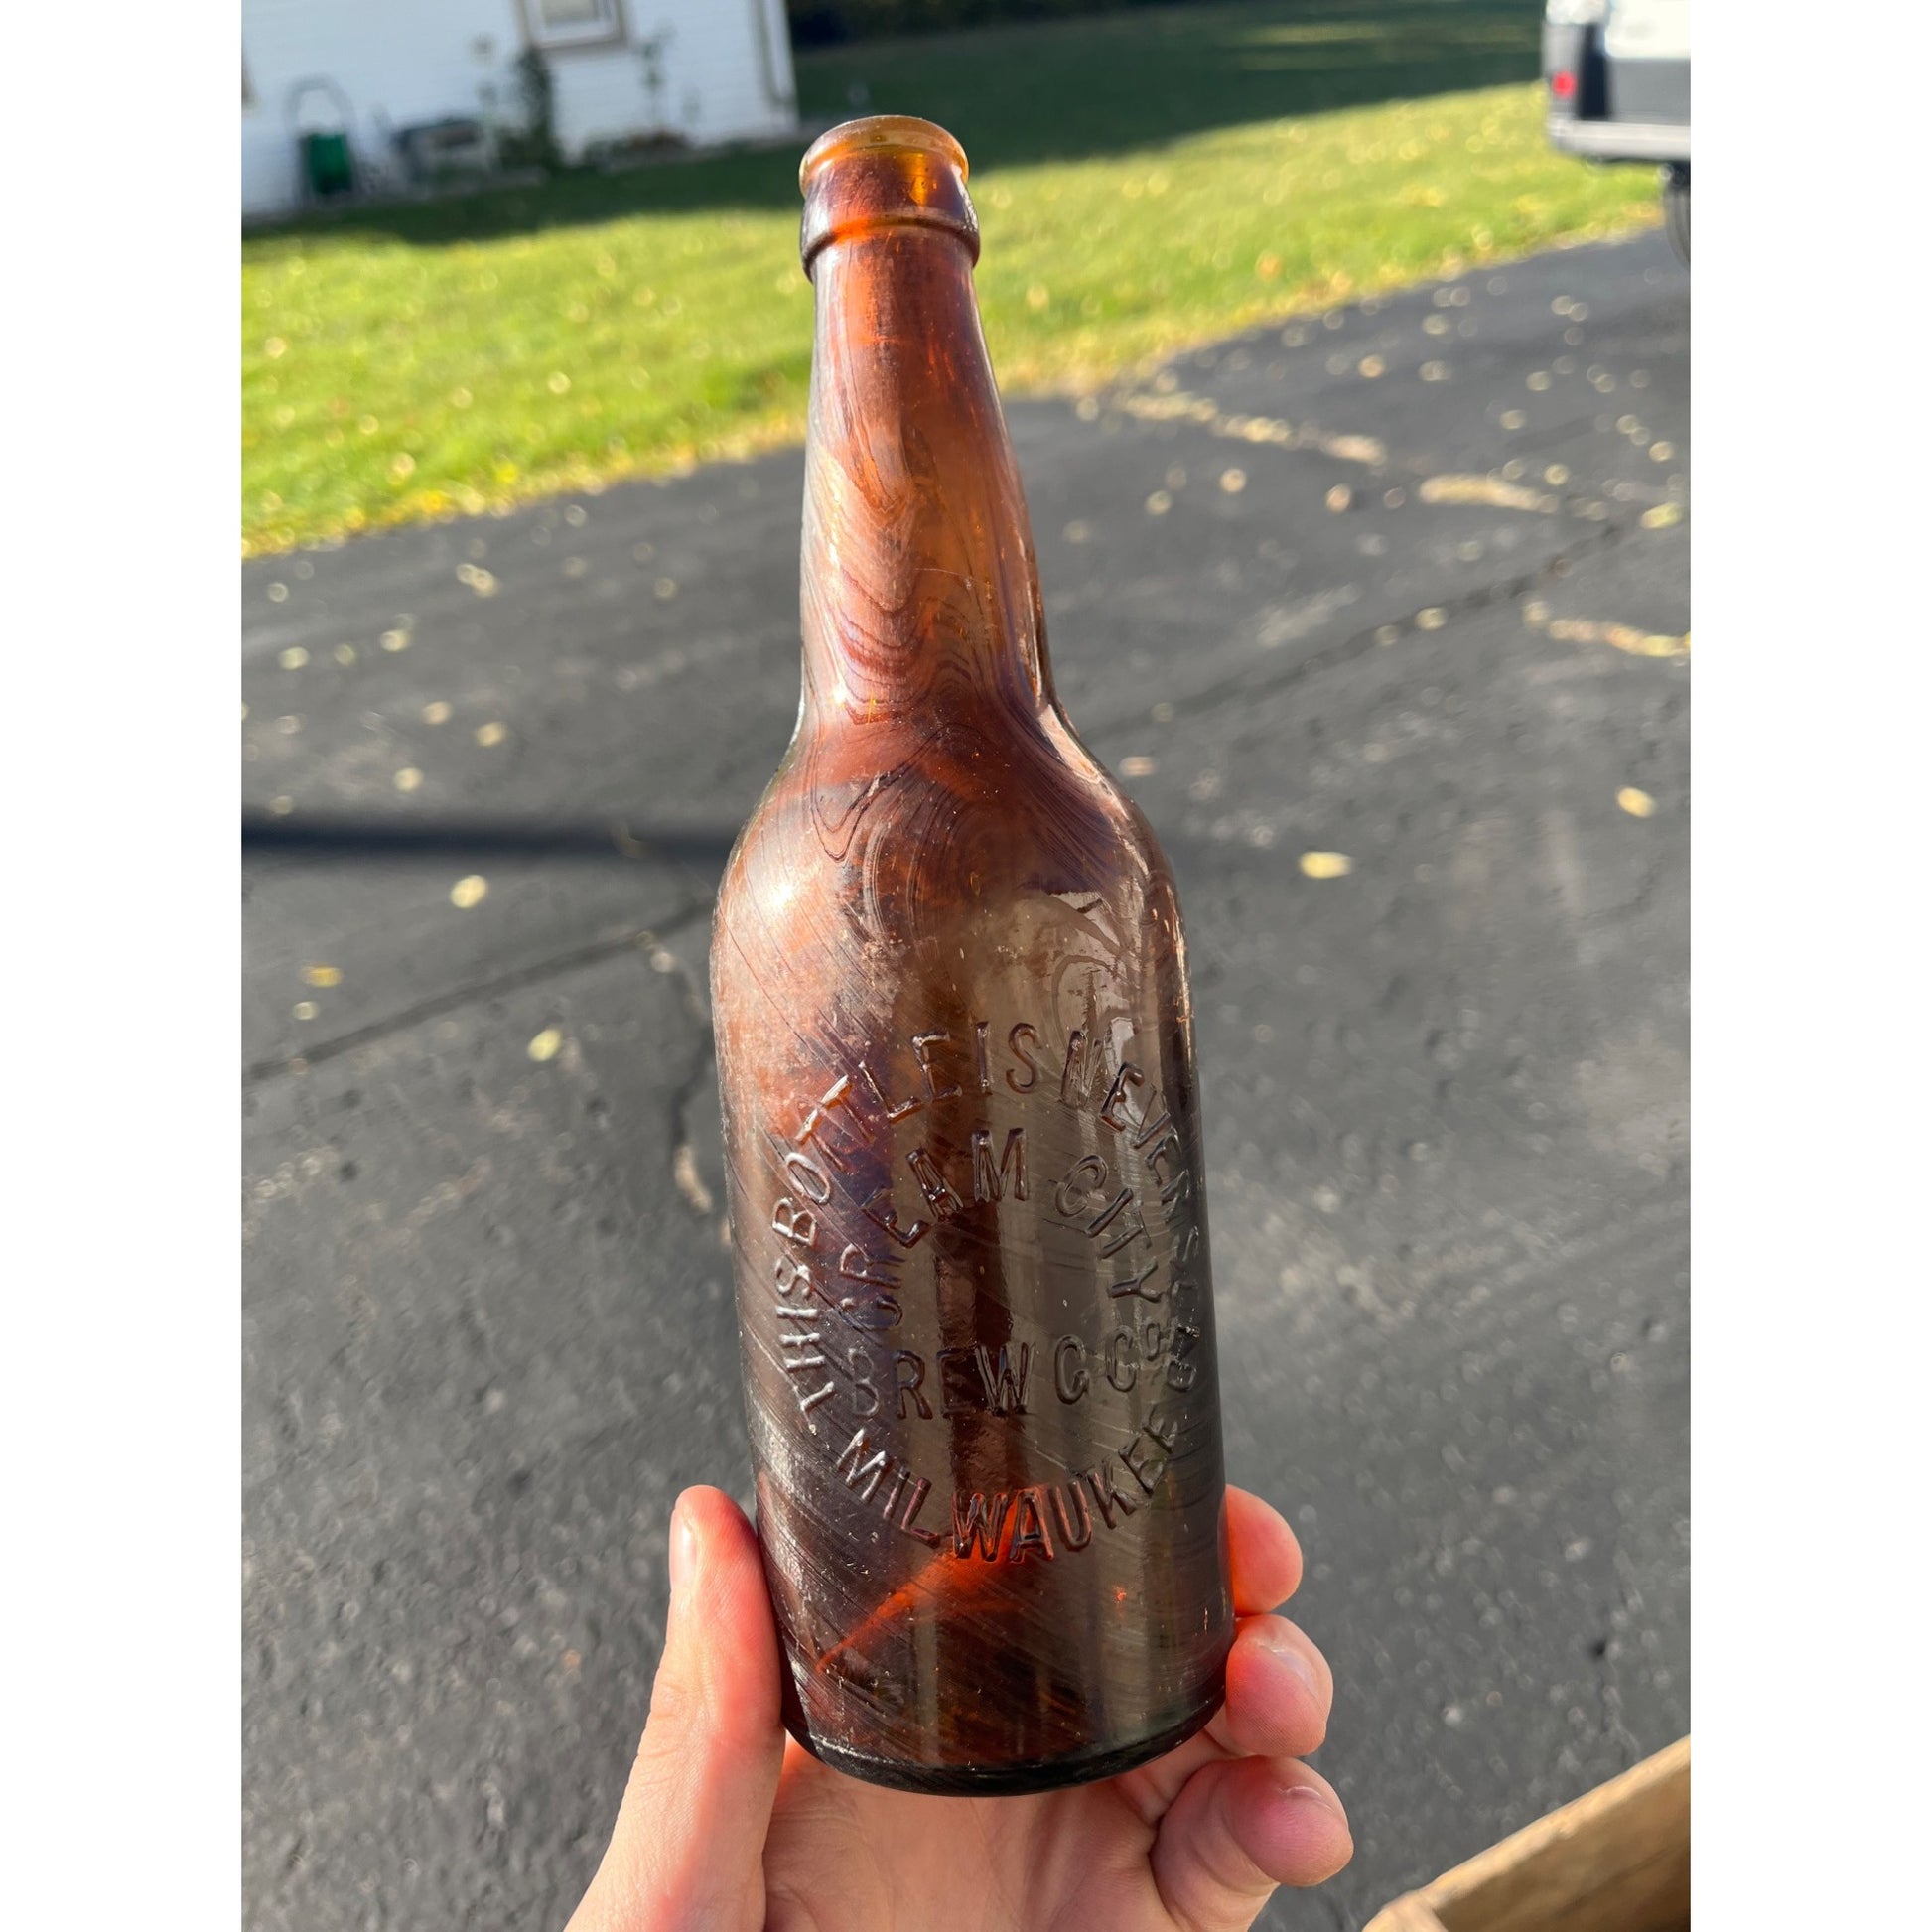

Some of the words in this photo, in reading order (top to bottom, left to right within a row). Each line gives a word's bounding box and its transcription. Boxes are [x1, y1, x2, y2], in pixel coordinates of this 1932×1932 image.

[771, 1030, 963, 1246] BOTTLE
[976, 1021, 1041, 1094] IS
[839, 1127, 1029, 1330] CREAM
[1054, 1154, 1163, 1303] CITY
[773, 1253, 835, 1436] THIS
[836, 1401, 1178, 1563] MILWAUKEE
